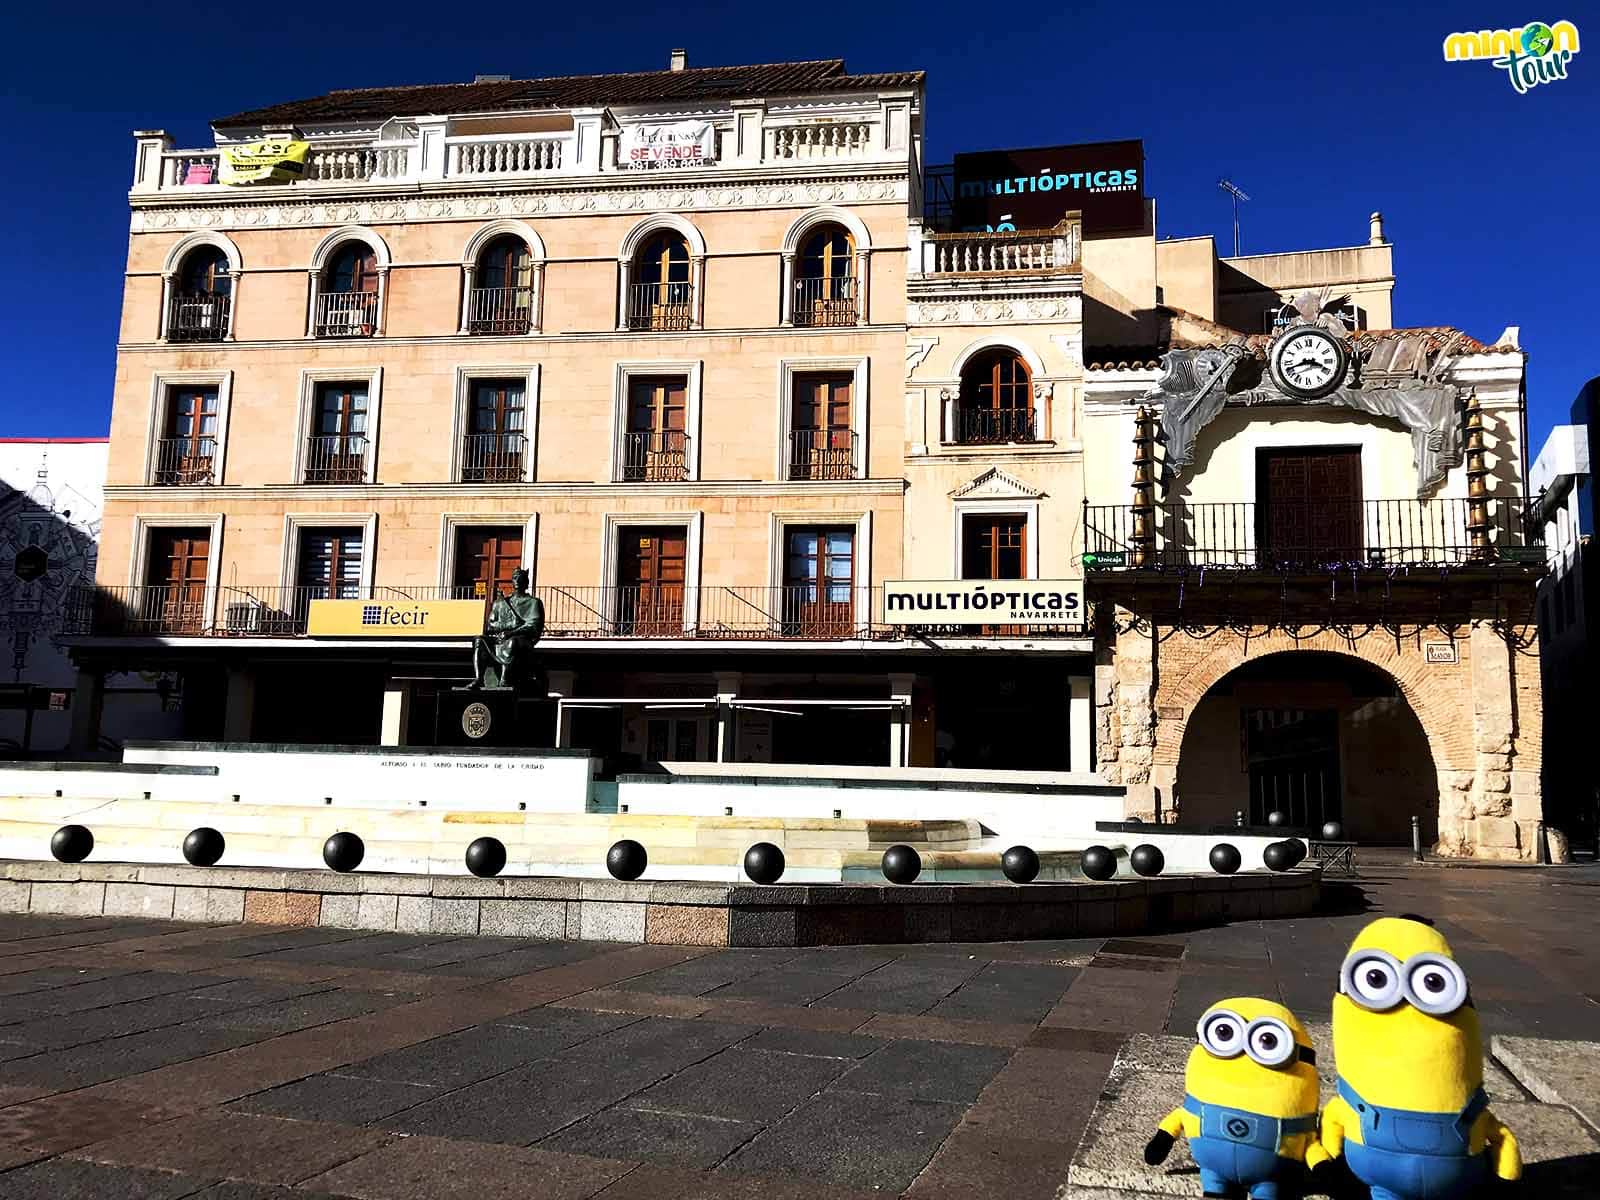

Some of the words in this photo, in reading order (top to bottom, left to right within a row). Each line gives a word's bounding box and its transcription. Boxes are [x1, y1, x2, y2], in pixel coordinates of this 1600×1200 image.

[630, 148, 649, 160] SE
[653, 145, 703, 159] VENDE
[1097, 556, 1123, 564] Unicaja
[383, 605, 429, 625] fecir
[1010, 611, 1079, 619] NAVARRETE
